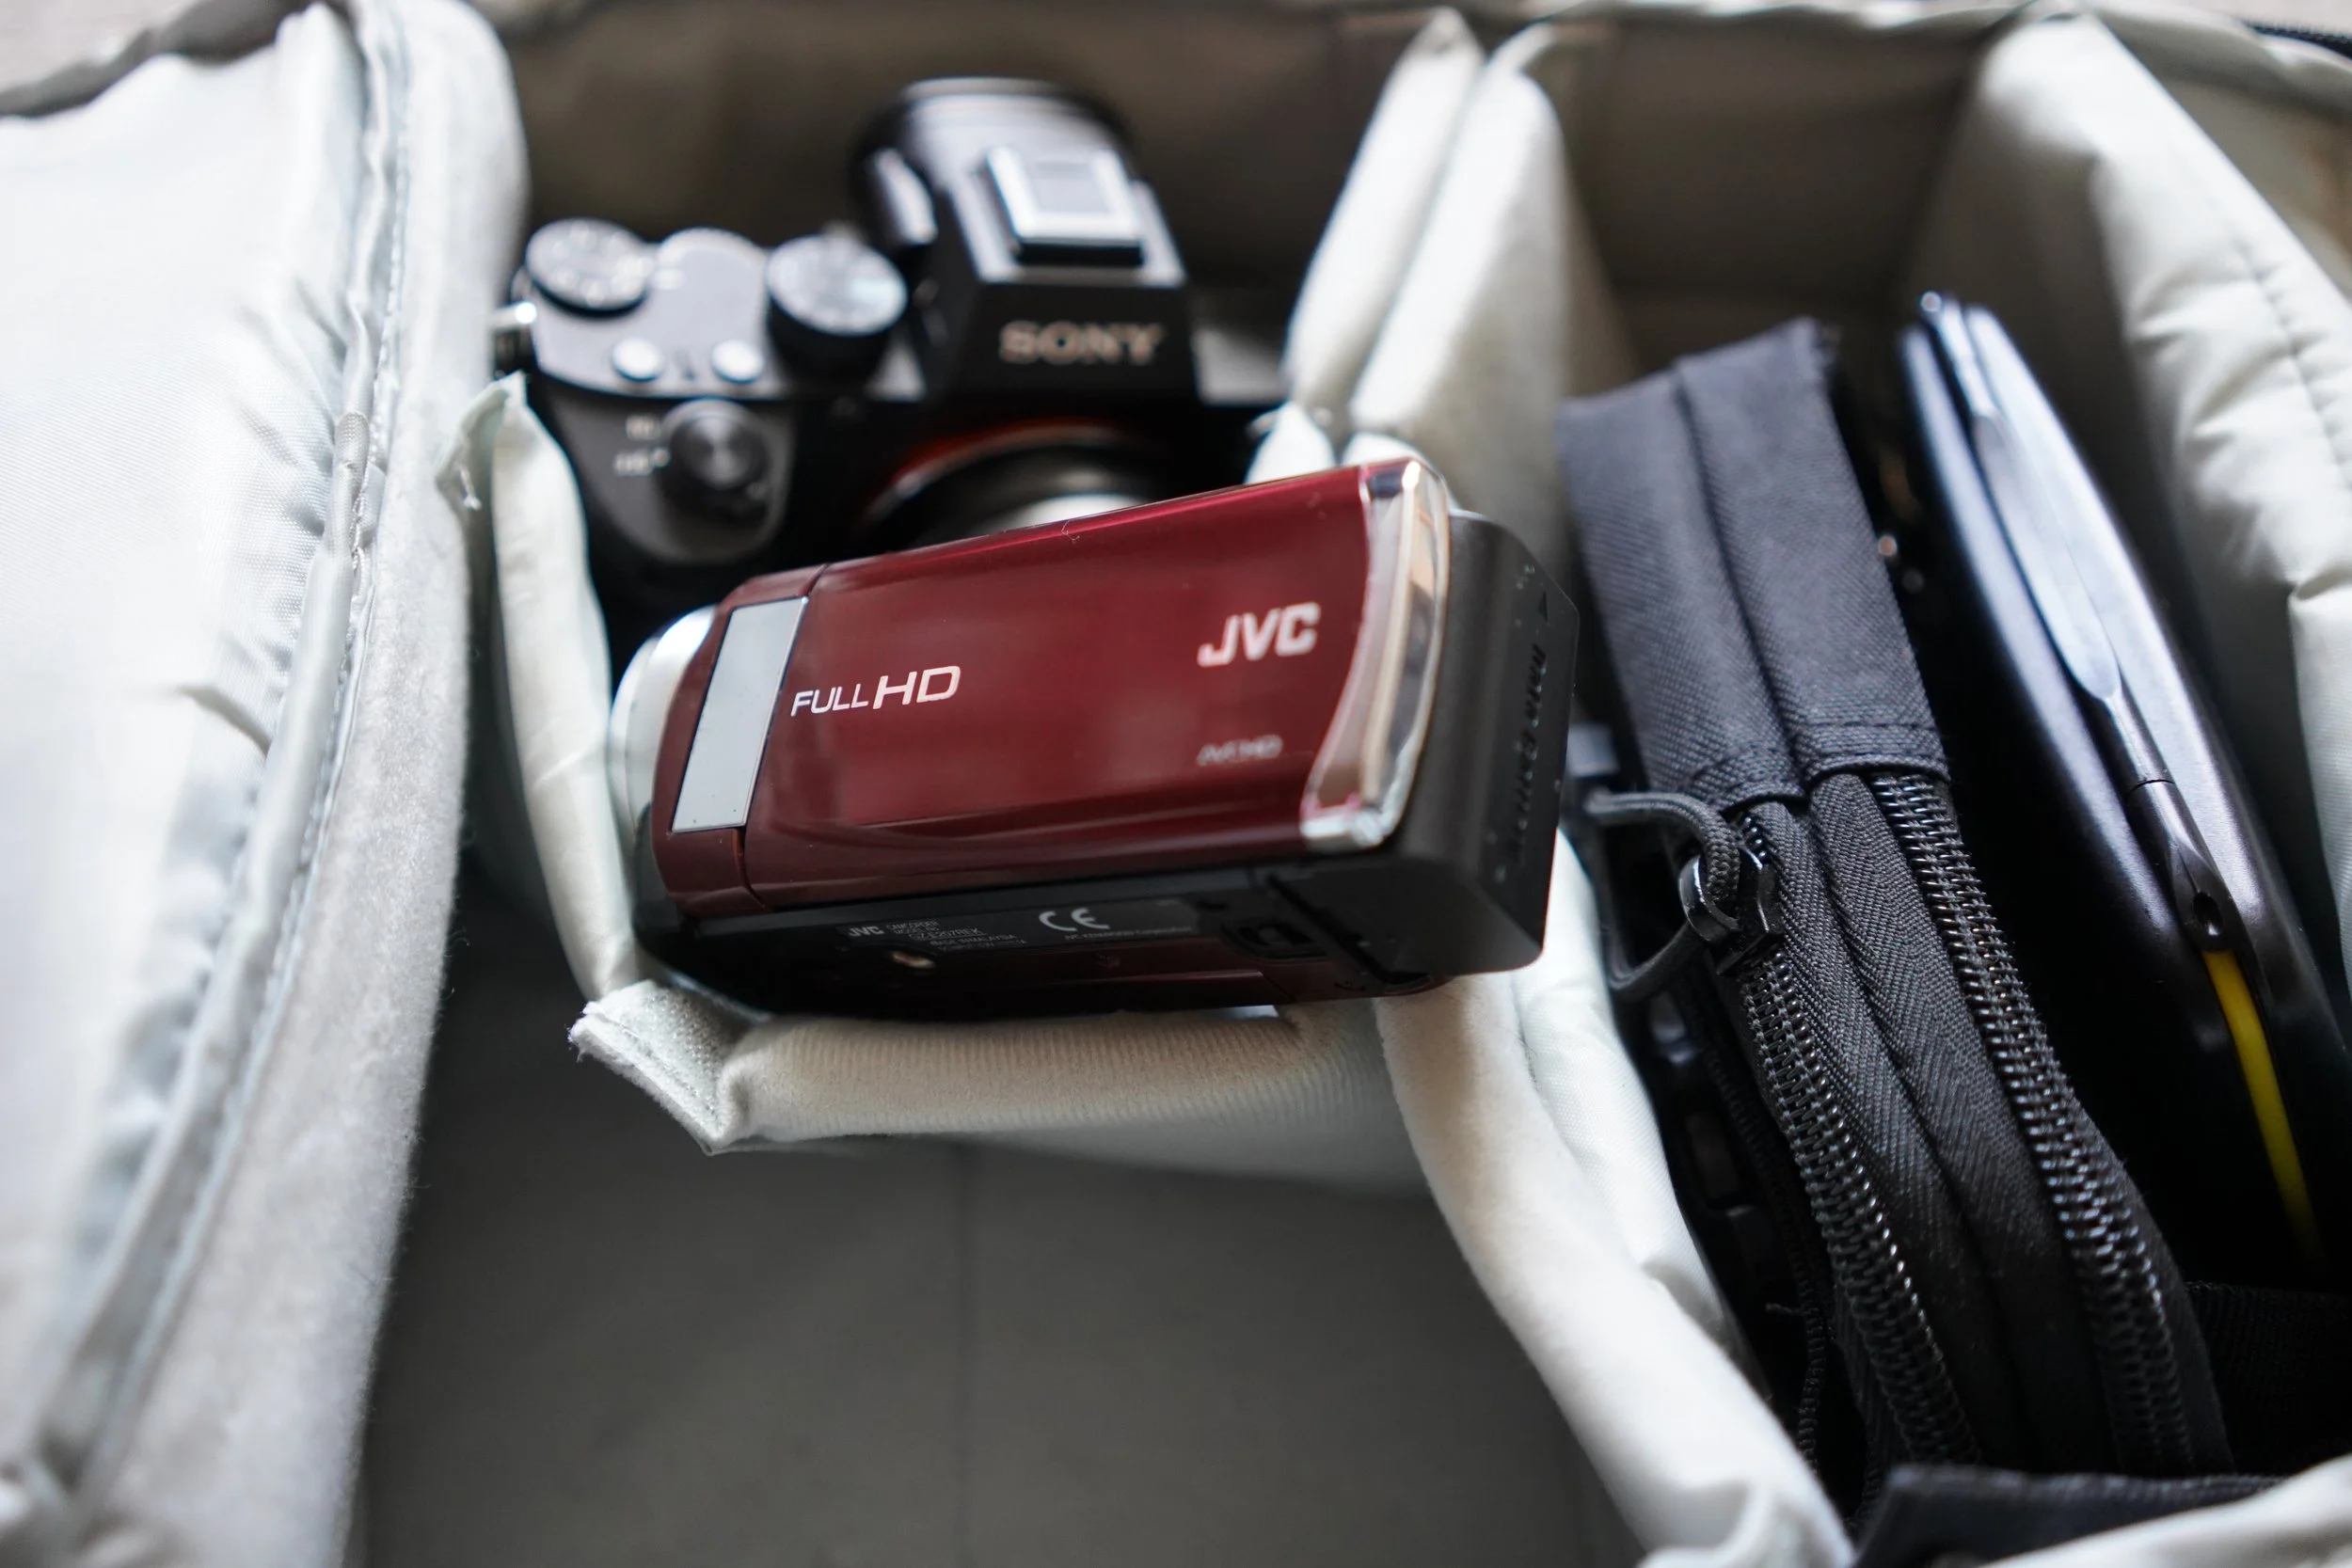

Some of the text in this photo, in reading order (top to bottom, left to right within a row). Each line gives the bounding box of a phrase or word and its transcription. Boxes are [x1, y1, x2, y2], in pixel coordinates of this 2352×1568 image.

[999, 322, 1163, 365] SONY
[1197, 602, 1321, 667] JVC
[791, 665, 961, 716] FULL HD
[849, 926, 884, 937] JVC
